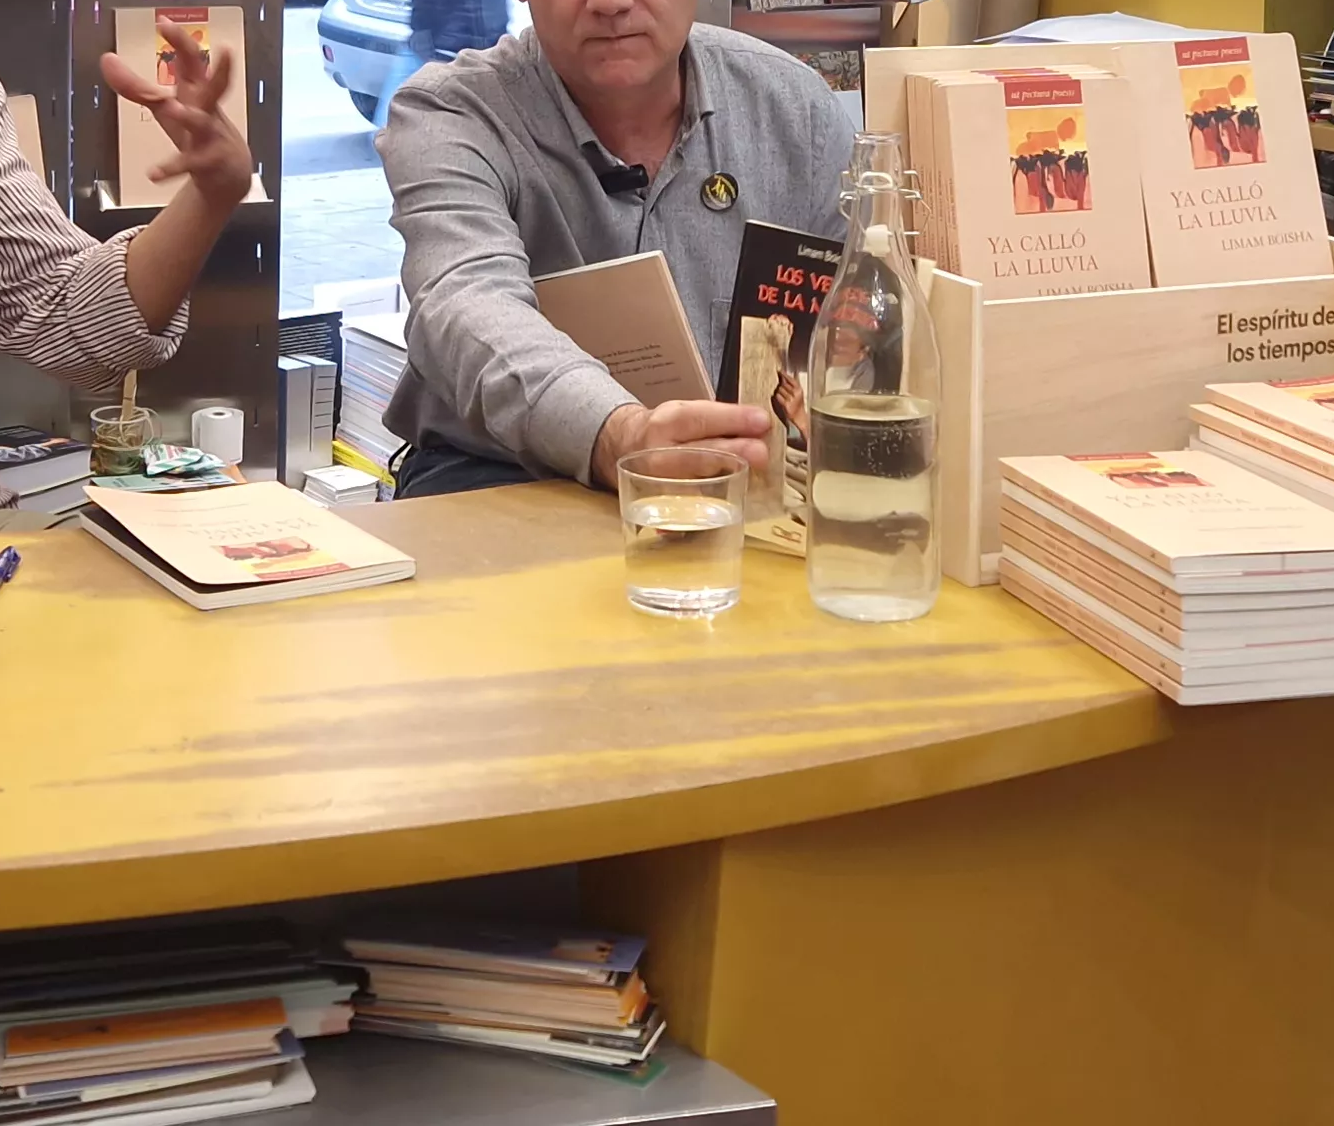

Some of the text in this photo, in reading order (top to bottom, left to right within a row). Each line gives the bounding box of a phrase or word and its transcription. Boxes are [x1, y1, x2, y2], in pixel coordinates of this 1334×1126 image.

[1170, 182, 1263, 209] YA CALLÓ
[1178, 206, 1277, 231] LA LLUVIA
[987, 228, 1086, 255] YA CALLÓ
[776, 264, 804, 286] LOS
[993, 255, 1099, 278] LA LLUVIA
[758, 283, 780, 305] DE
[784, 290, 805, 314] LA
[1217, 312, 1234, 335] El
[1236, 307, 1309, 338] espíritu
[1227, 342, 1255, 364] los
